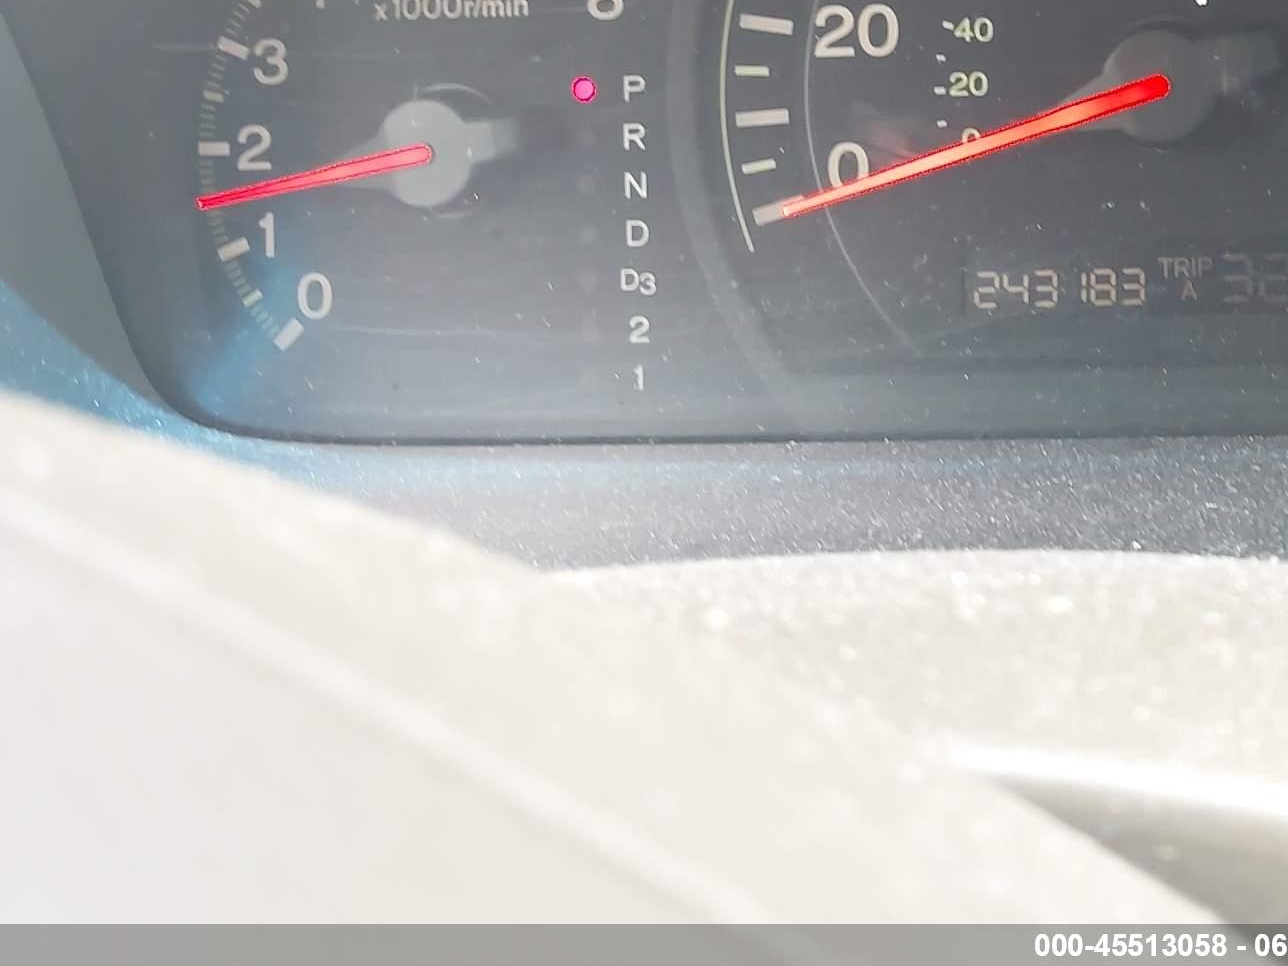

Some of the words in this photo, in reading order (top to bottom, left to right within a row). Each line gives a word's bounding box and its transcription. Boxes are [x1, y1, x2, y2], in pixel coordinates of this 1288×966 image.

[814, 4, 900, 58] 20
[953, 18, 994, 43] 40
[253, 39, 288, 85] 3
[623, 75, 645, 102] P
[948, 71, 989, 97] 20
[236, 125, 272, 171] 2
[623, 124, 645, 150] R
[827, 141, 870, 188] 0
[624, 172, 648, 199] N
[258, 212, 276, 259] 1
[625, 220, 650, 247] D
[620, 268, 657, 295] D3
[298, 273, 333, 320] 0
[628, 317, 650, 343] 2
[633, 365, 645, 391] 1
